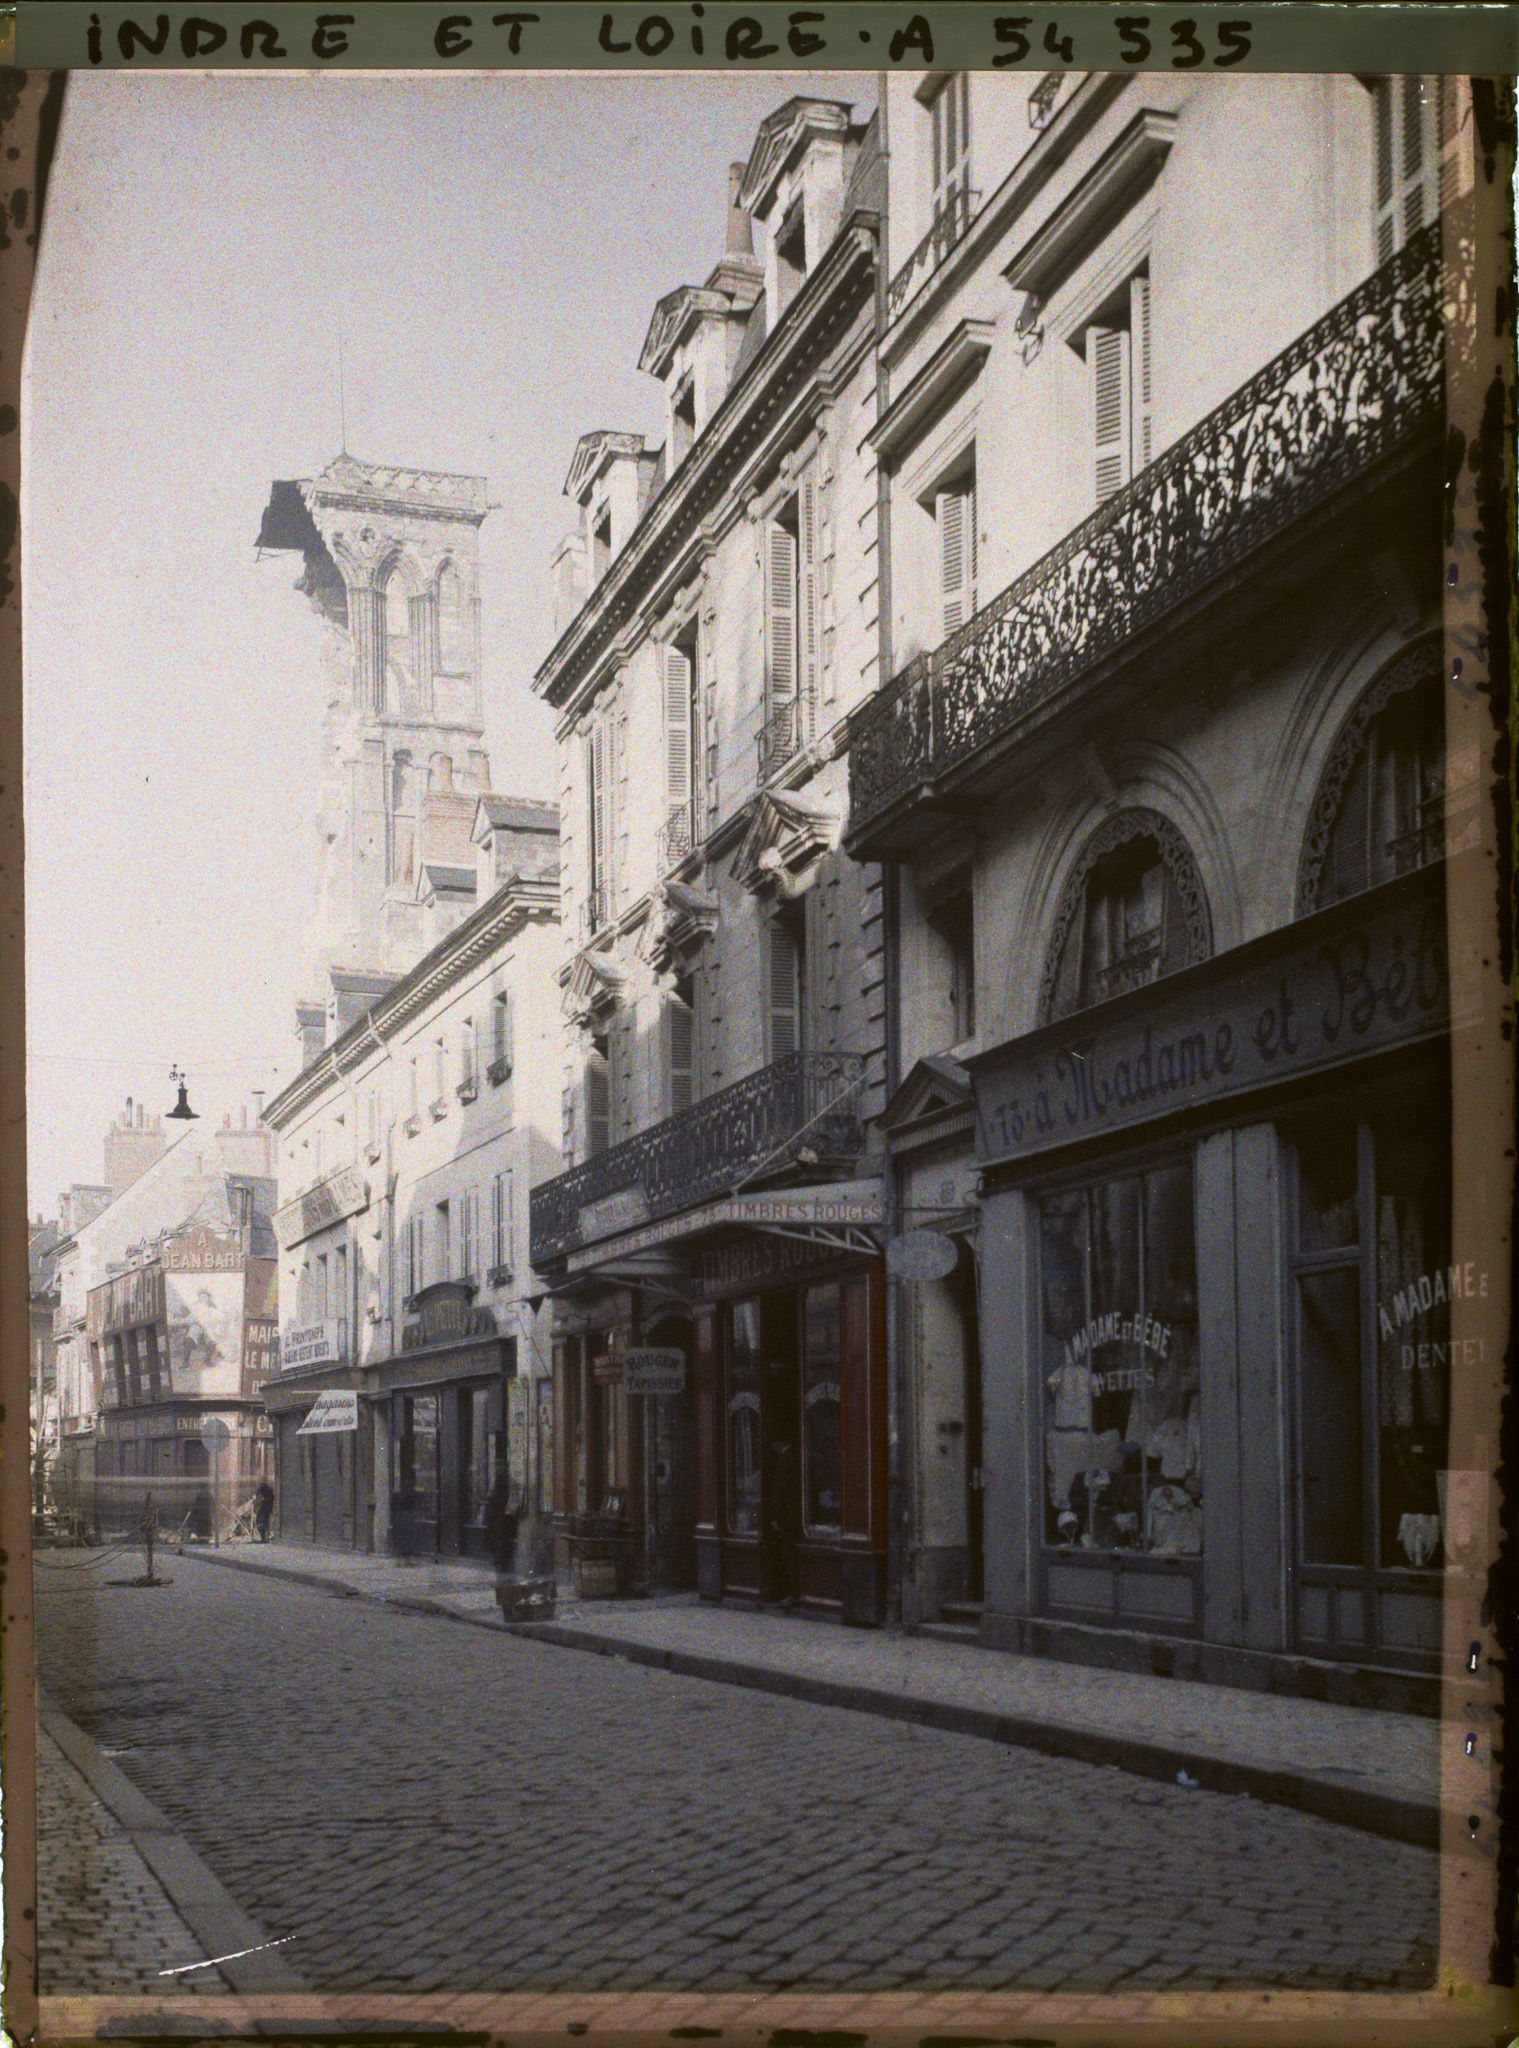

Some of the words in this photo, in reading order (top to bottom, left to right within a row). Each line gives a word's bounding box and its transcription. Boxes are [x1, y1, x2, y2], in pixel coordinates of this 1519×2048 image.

[1055, 1024, 1241, 1125] Madame
[1252, 977, 1301, 1062] et
[726, 1201, 807, 1221] TIMBRES
[813, 1202, 881, 1222] ROUGES
[160, 1252, 201, 1269] JEAN
[204, 1252, 247, 1269] BART
[1393, 1261, 1476, 1328] MADAME
[1072, 1312, 1121, 1362] MADAME
[627, 1376, 683, 1391] TAPISSIER
